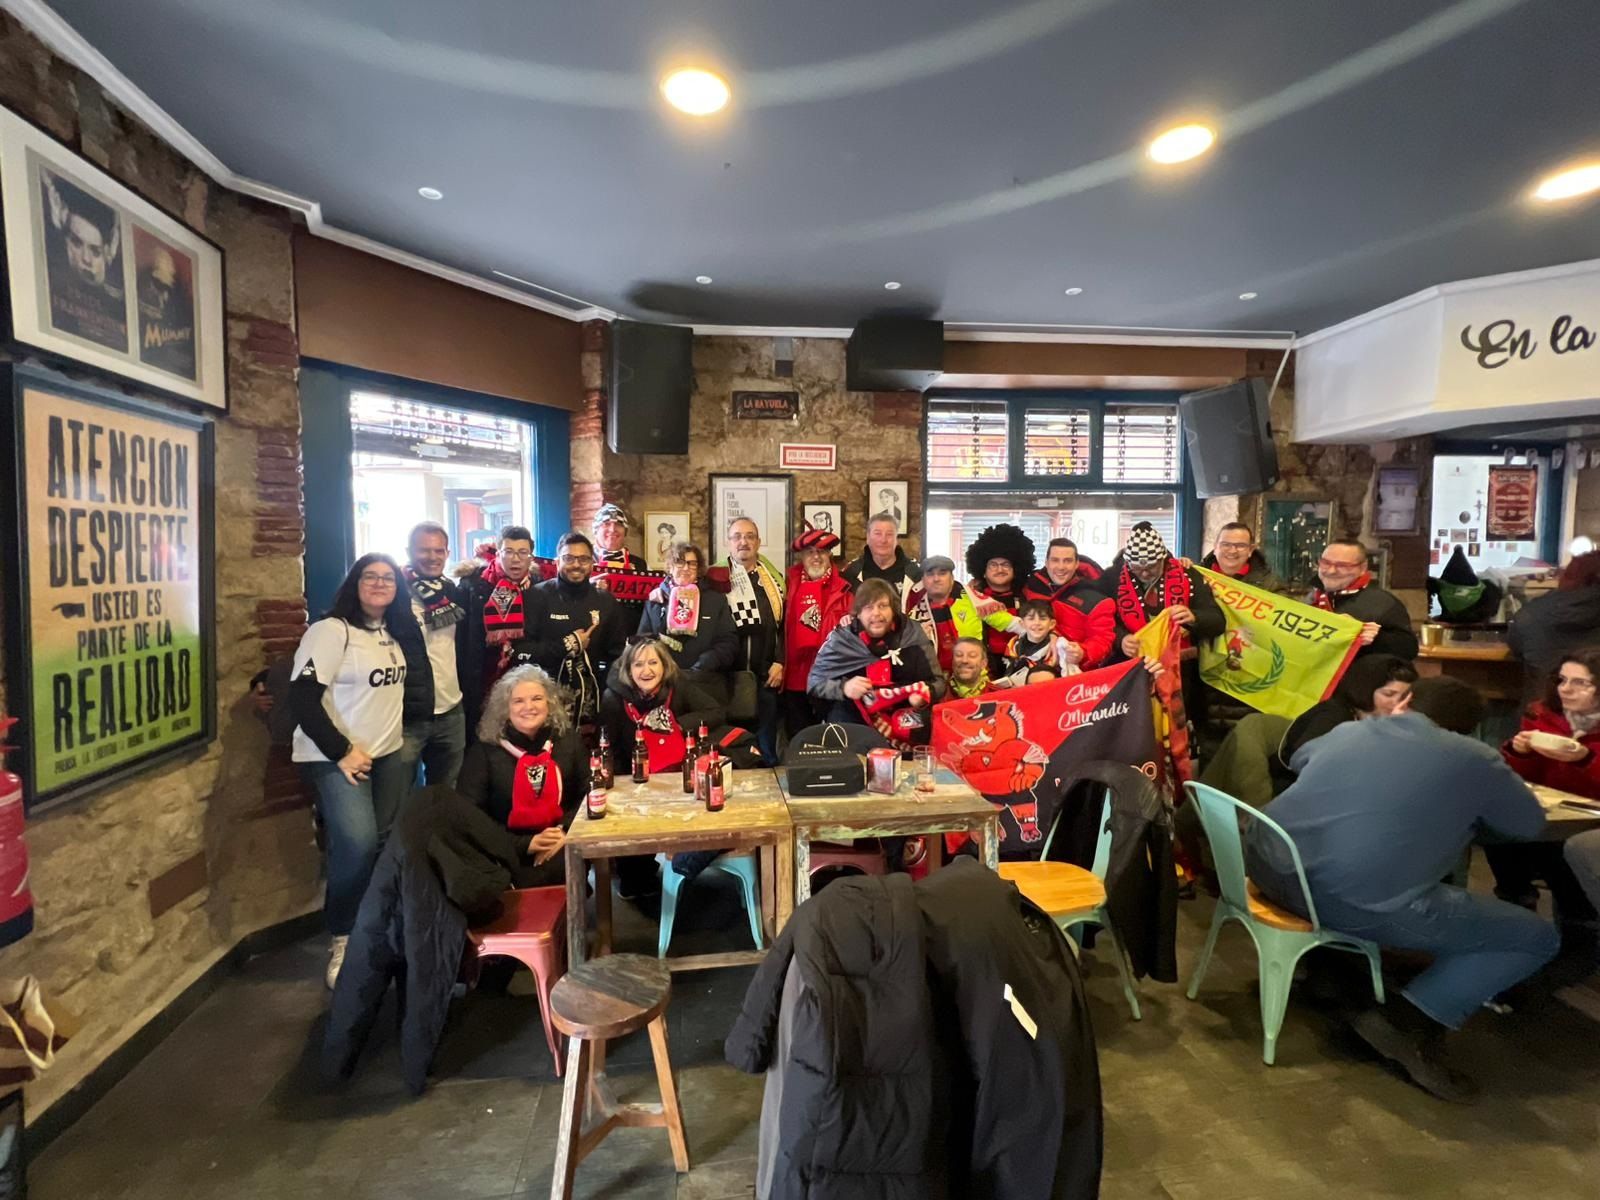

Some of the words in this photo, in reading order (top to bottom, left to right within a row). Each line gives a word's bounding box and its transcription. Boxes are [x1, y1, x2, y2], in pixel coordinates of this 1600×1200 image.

[1461, 319, 1537, 369] En
[1550, 315, 1597, 354] la
[48, 506, 189, 588] DESPIERTE
[92, 590, 139, 623] USTED
[146, 589, 162, 617] ES
[77, 625, 127, 662] PARTE
[134, 622, 150, 651] DE
[157, 619, 172, 647] LA
[1272, 610, 1338, 642] 1927
[53, 648, 191, 754] REALIDAD
[1066, 683, 1111, 705] Aupa
[1058, 702, 1130, 731] Mirandés
